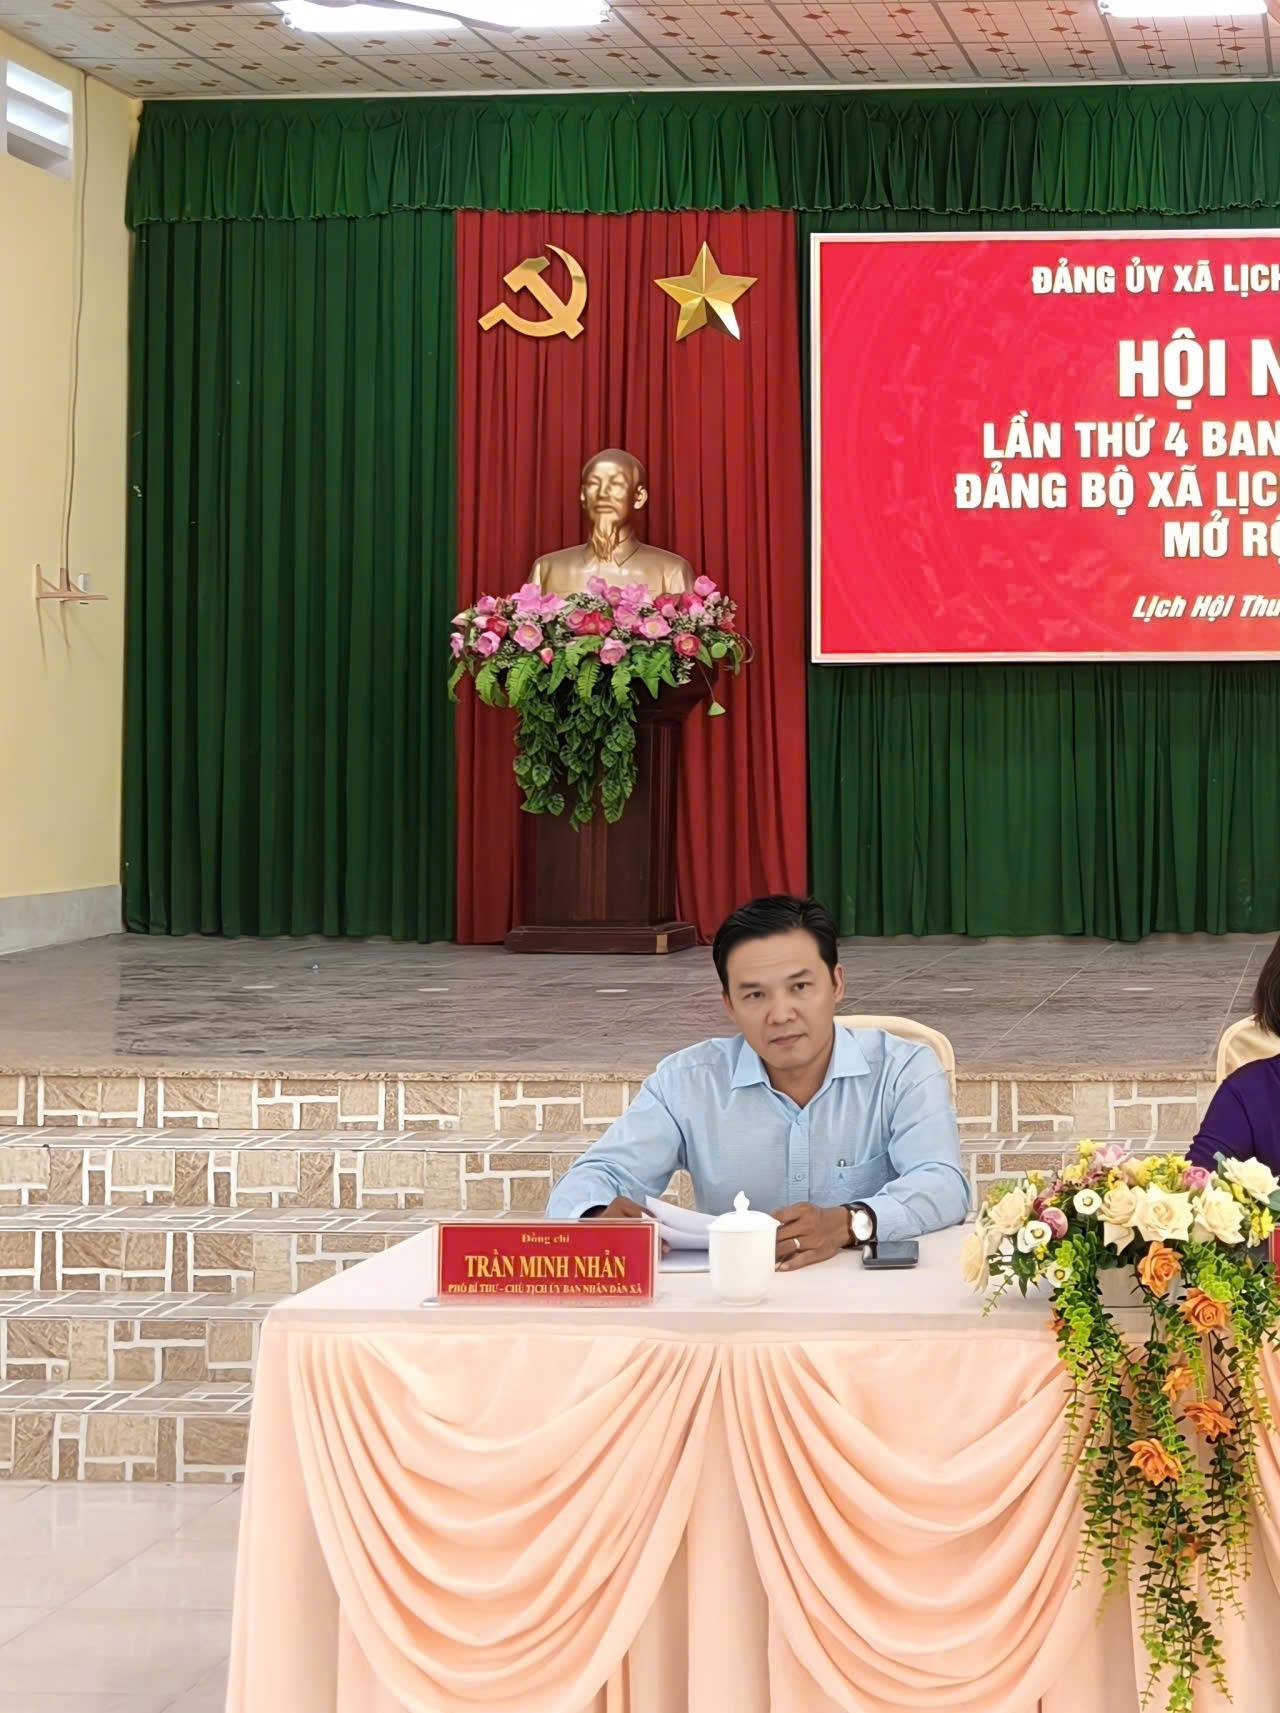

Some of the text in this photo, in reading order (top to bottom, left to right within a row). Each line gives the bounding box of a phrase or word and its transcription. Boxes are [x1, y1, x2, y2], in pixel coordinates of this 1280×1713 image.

[1031, 257, 1116, 294] ĐẢNG
[1125, 256, 1164, 294] ỦY
[1173, 259, 1215, 293] XÃ
[1118, 327, 1226, 410] HỘI
[983, 410, 1061, 459] LẦN
[1074, 413, 1156, 458] THỨ
[1164, 421, 1189, 458] 4
[954, 460, 1067, 509] ĐẢNG
[1081, 464, 1134, 516] BỘ
[1147, 464, 1203, 508] XÃ
[1163, 510, 1230, 558] MỞ
[1132, 595, 1187, 622] Lịch
[1190, 594, 1236, 622] Hội
[519, 1255, 569, 1278] MINH
